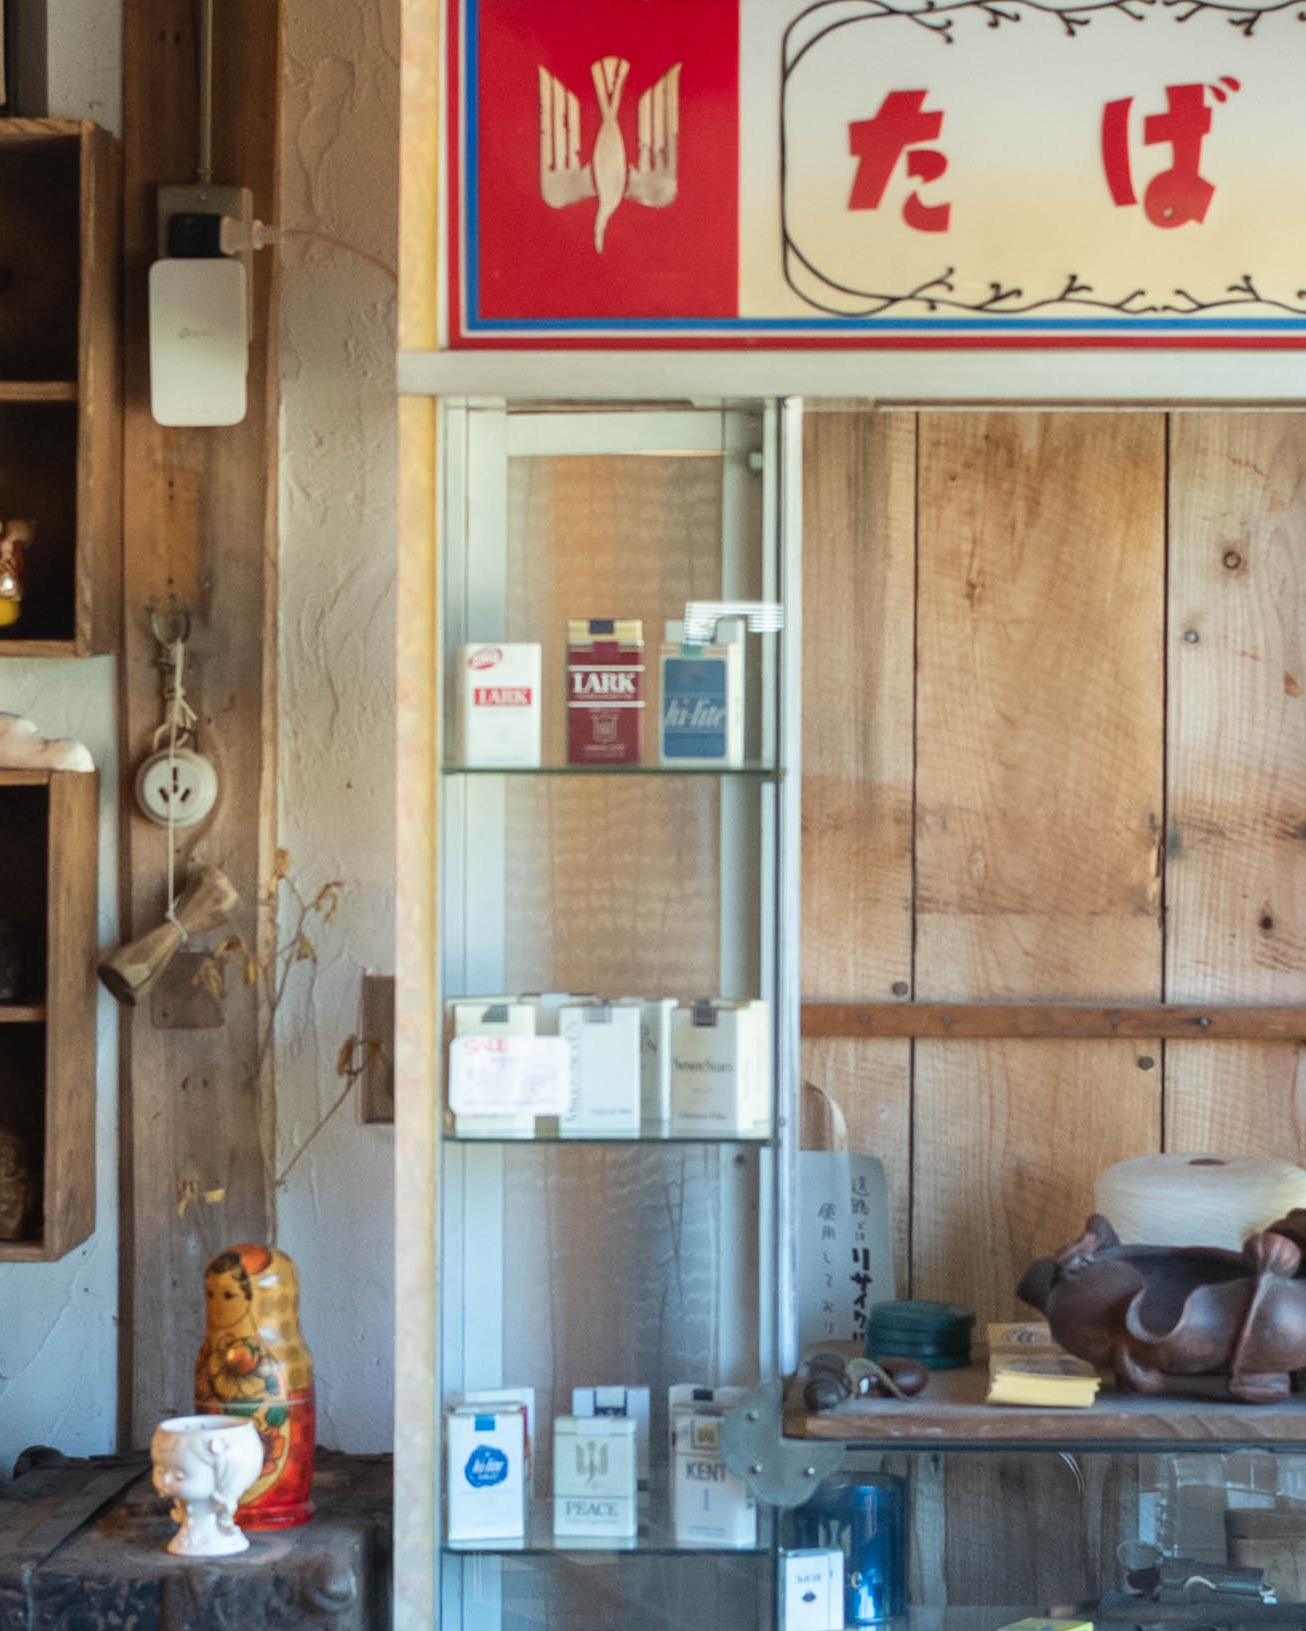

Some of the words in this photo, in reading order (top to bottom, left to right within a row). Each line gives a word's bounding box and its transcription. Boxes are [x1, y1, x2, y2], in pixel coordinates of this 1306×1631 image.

[572, 672, 636, 694] LARK
[479, 689, 530, 705] LARK
[686, 1460, 726, 1482] KENT
[566, 1501, 618, 1517] PEACE
